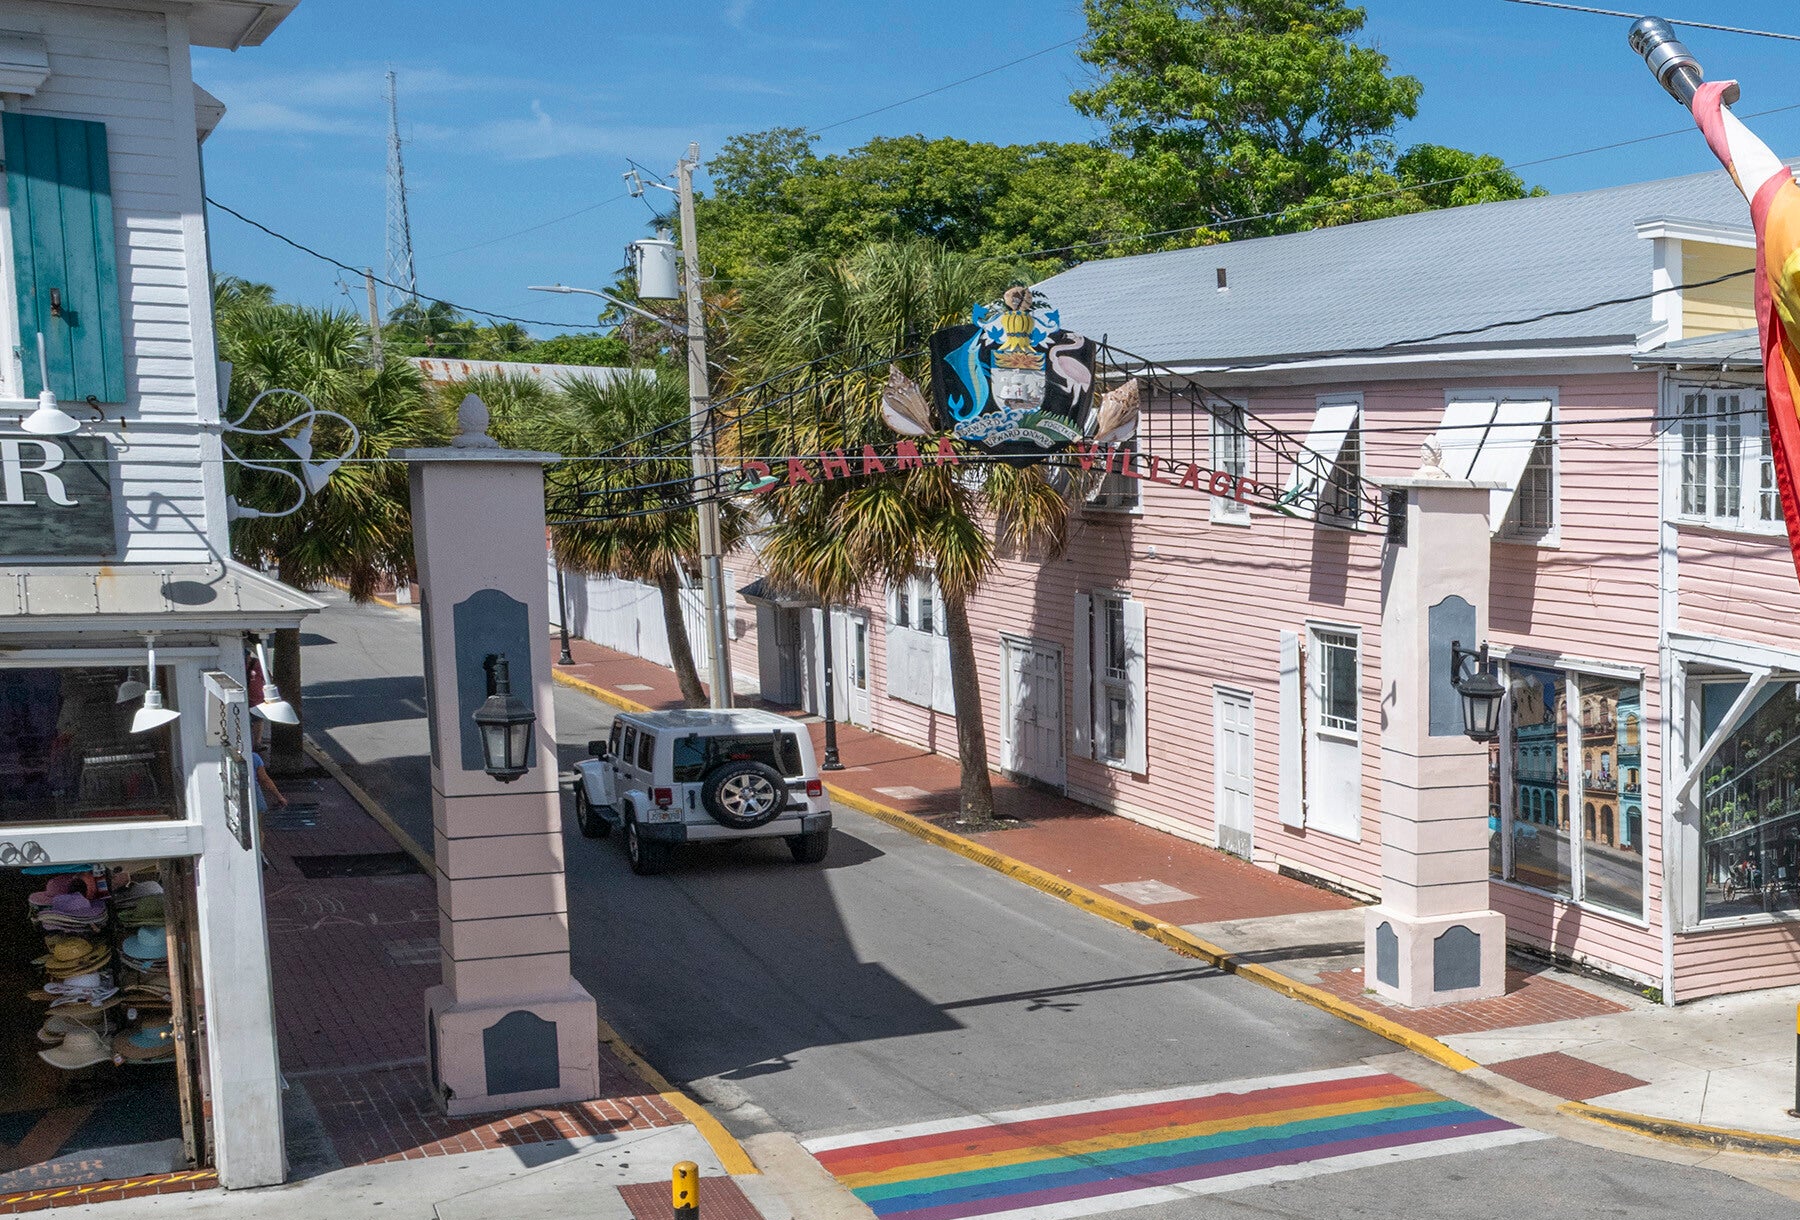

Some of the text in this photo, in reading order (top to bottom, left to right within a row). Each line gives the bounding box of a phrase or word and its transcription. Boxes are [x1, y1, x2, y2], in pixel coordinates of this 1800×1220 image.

[986, 429, 1020, 446] UPWARD
[742, 436, 1258, 507] BAHAMA VILLAGE
